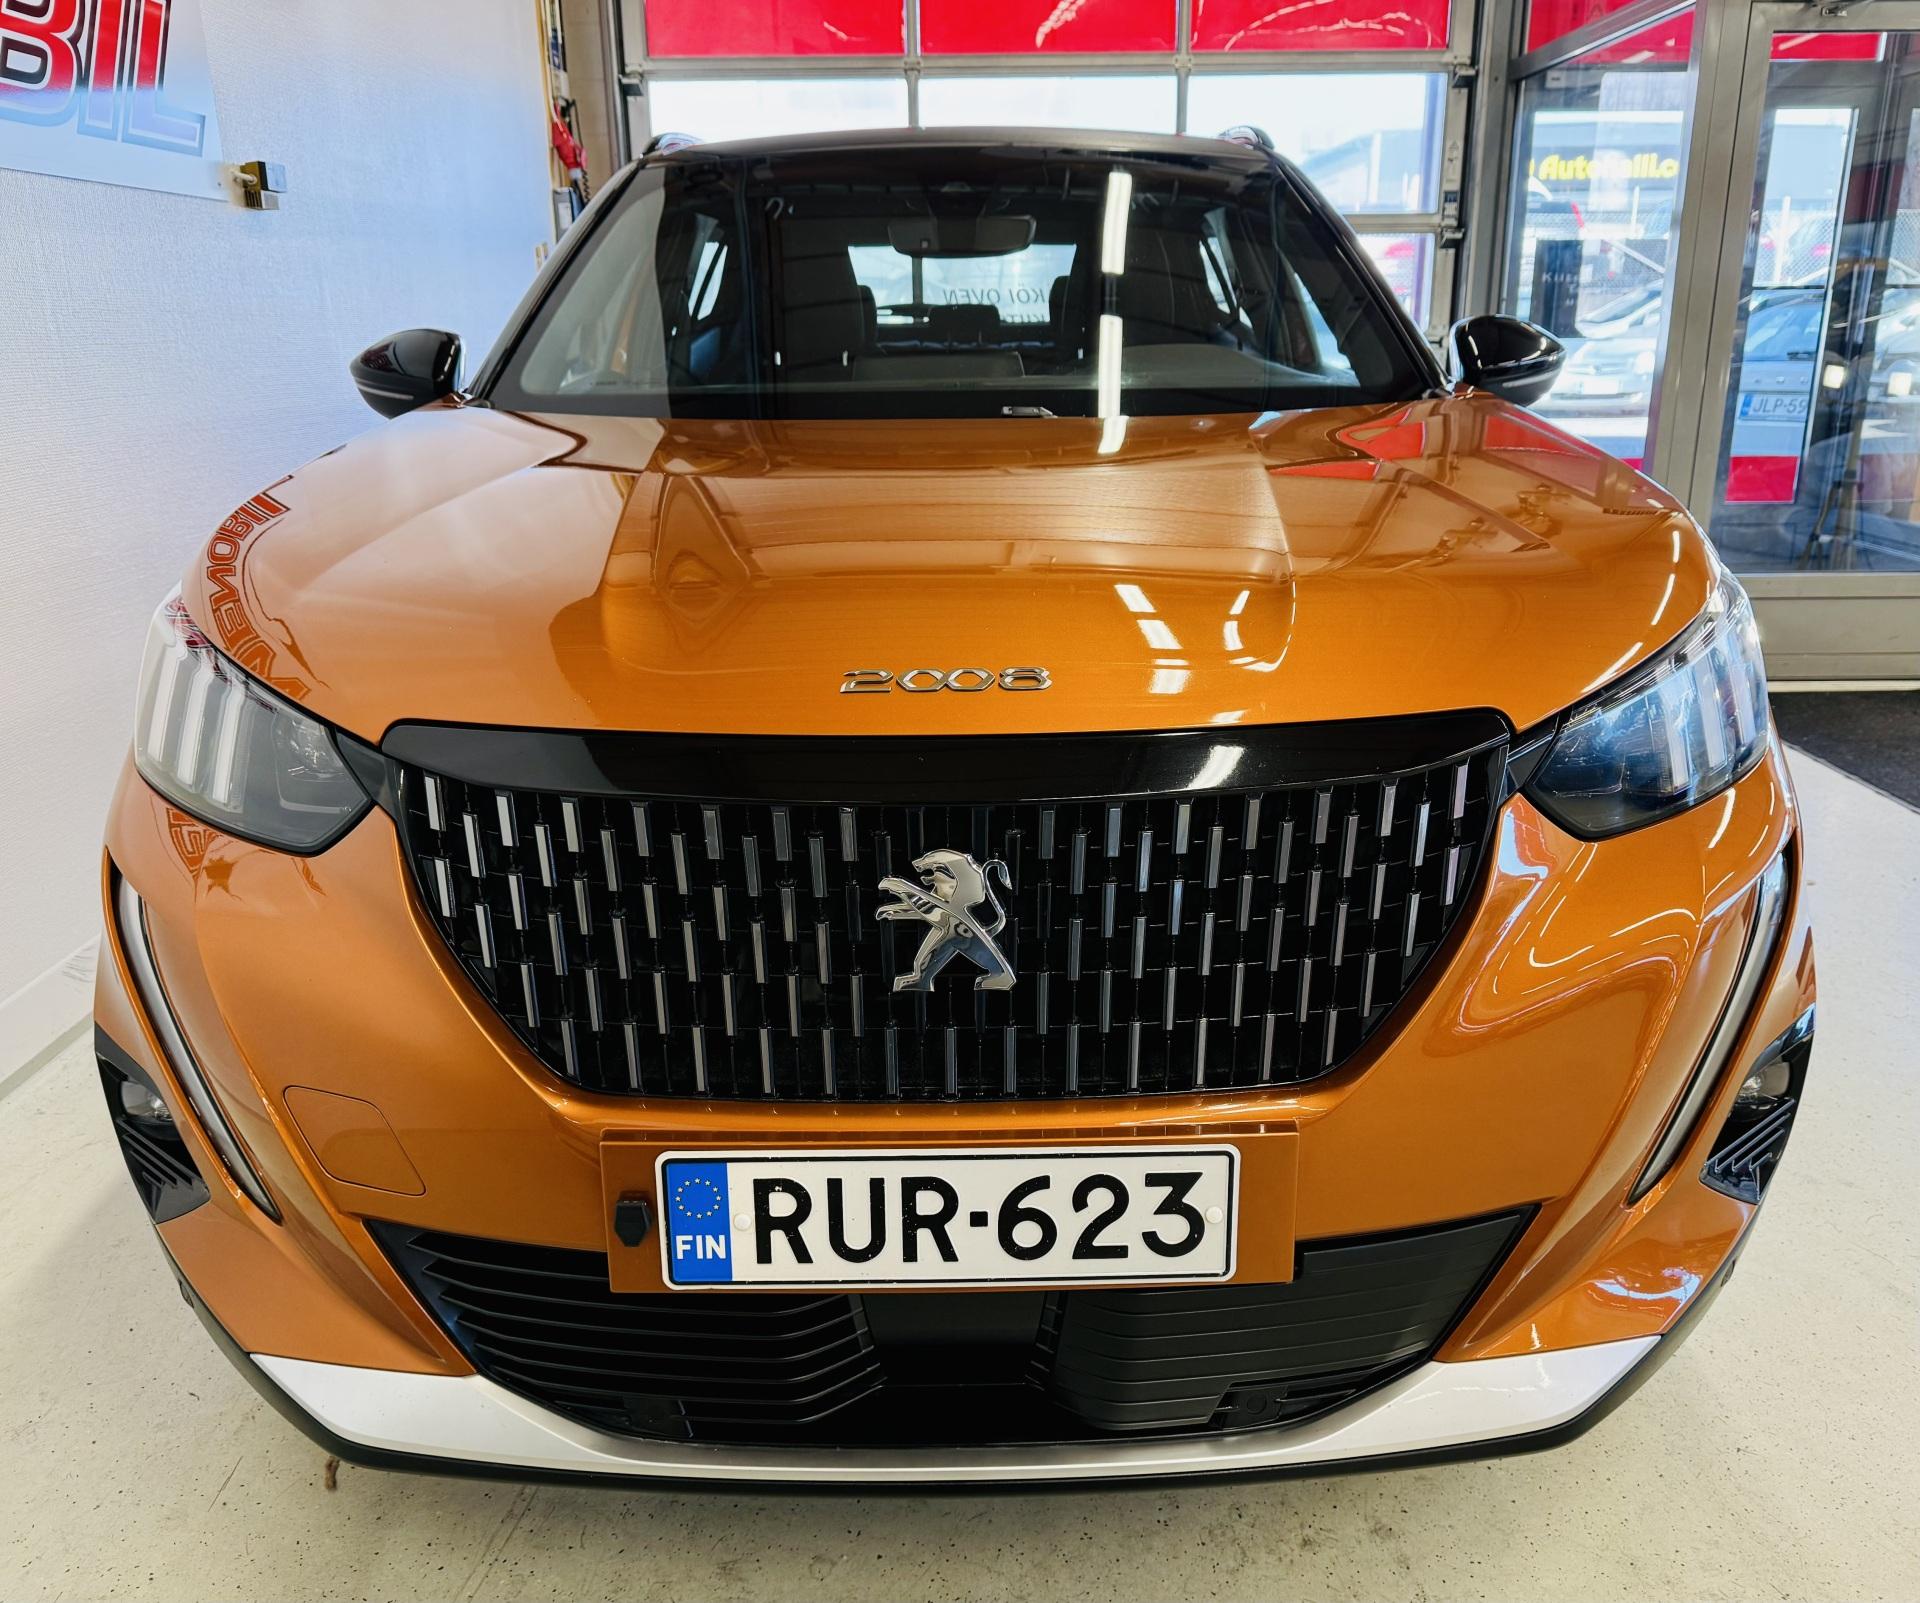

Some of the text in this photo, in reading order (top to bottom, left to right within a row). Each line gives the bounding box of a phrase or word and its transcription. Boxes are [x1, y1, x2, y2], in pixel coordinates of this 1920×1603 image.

[840, 666, 1053, 693] 2008
[752, 1171, 1206, 1265] RUR-623
[675, 1234, 728, 1261] FIN
